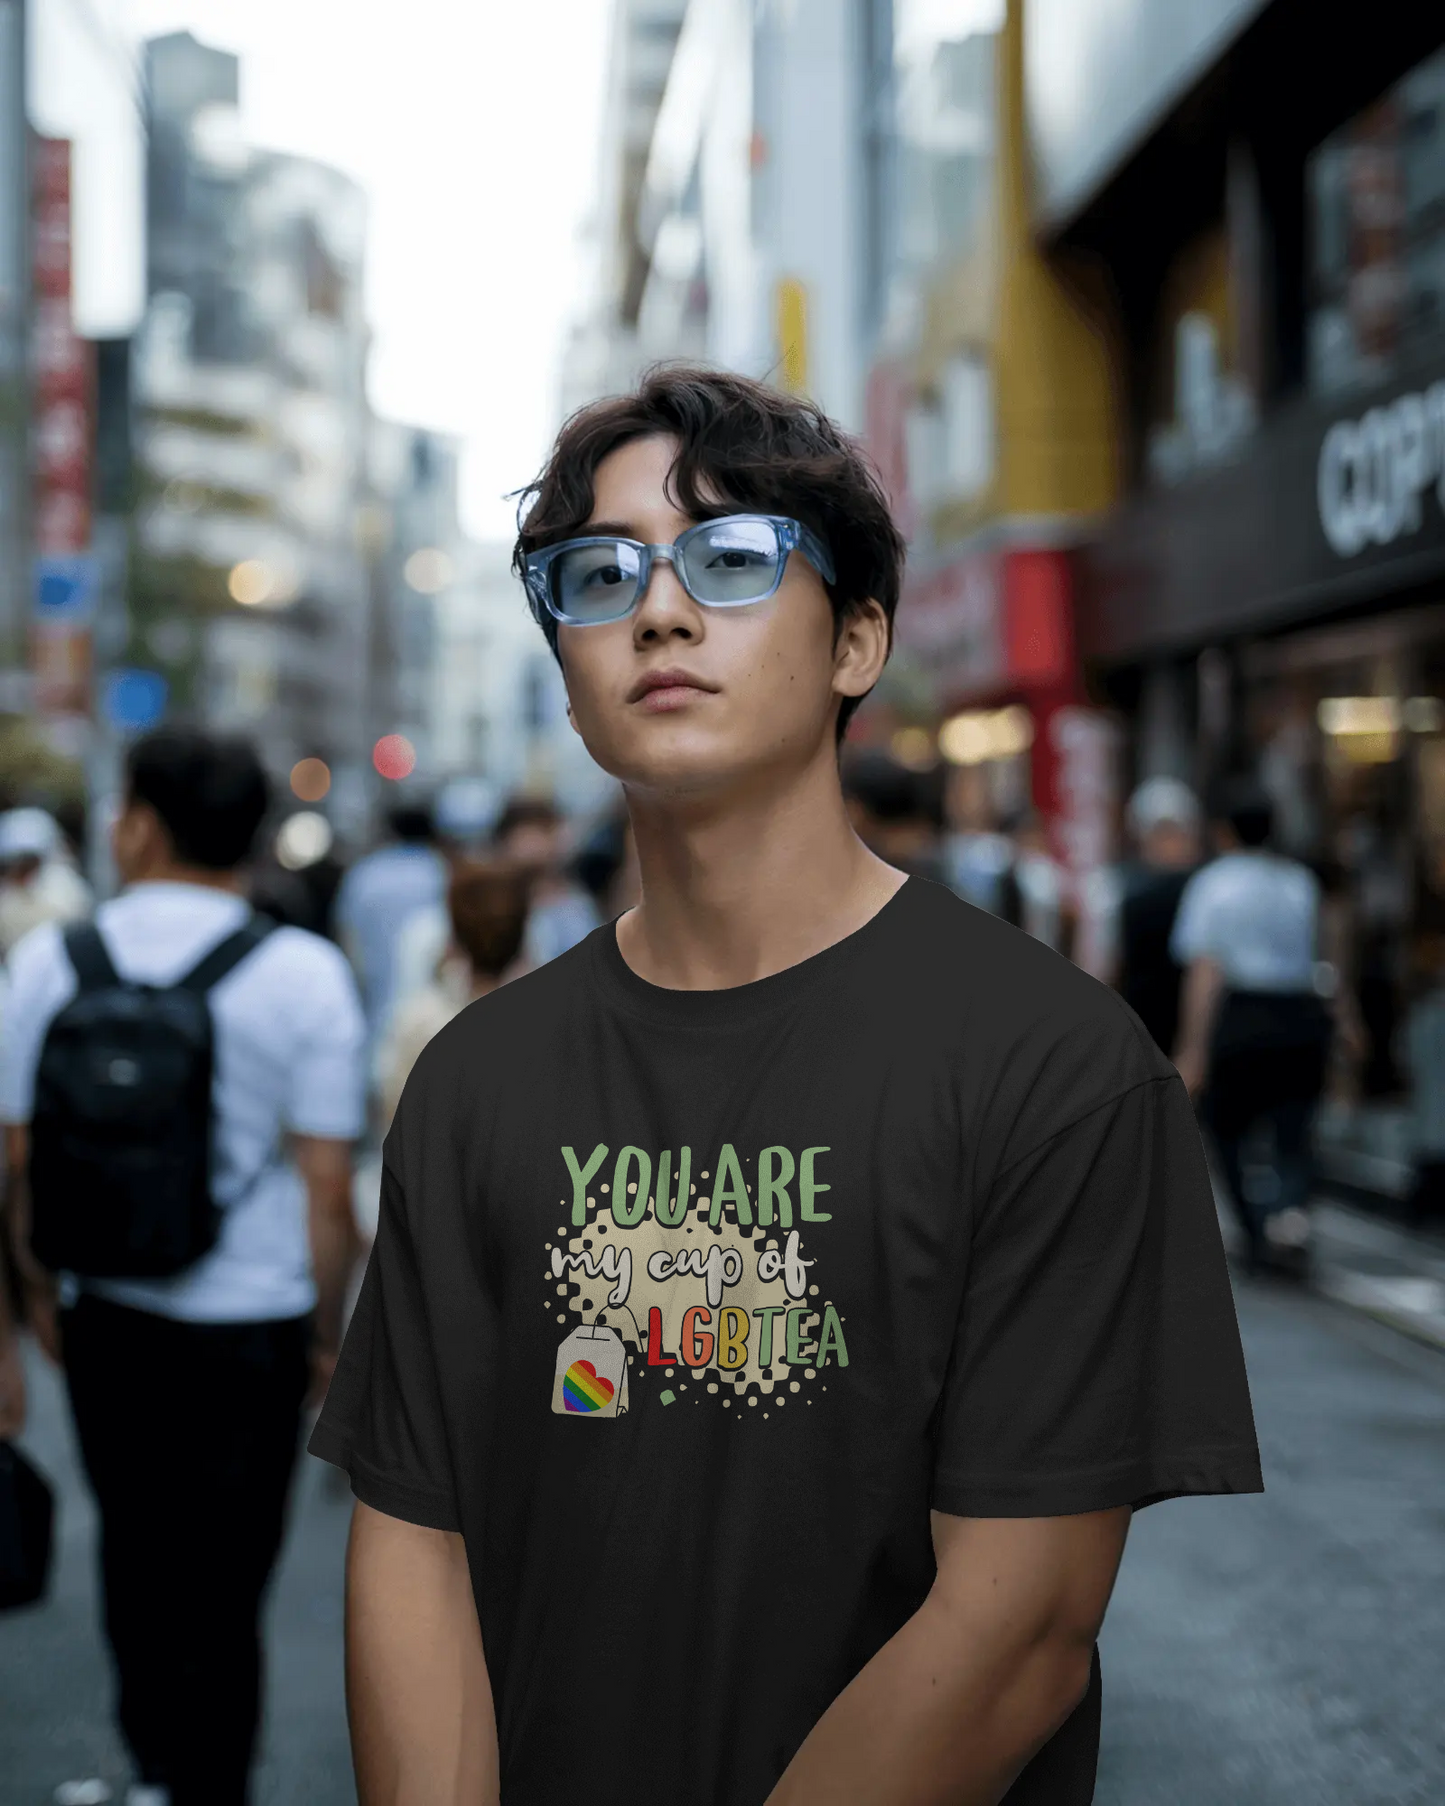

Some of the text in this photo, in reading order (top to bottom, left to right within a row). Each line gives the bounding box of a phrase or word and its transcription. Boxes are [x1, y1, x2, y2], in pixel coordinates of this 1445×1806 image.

[561, 1143, 833, 1228] YOU ARE
[551, 1230, 814, 1305] my cup of
[647, 1306, 849, 1368] LGBTEA
